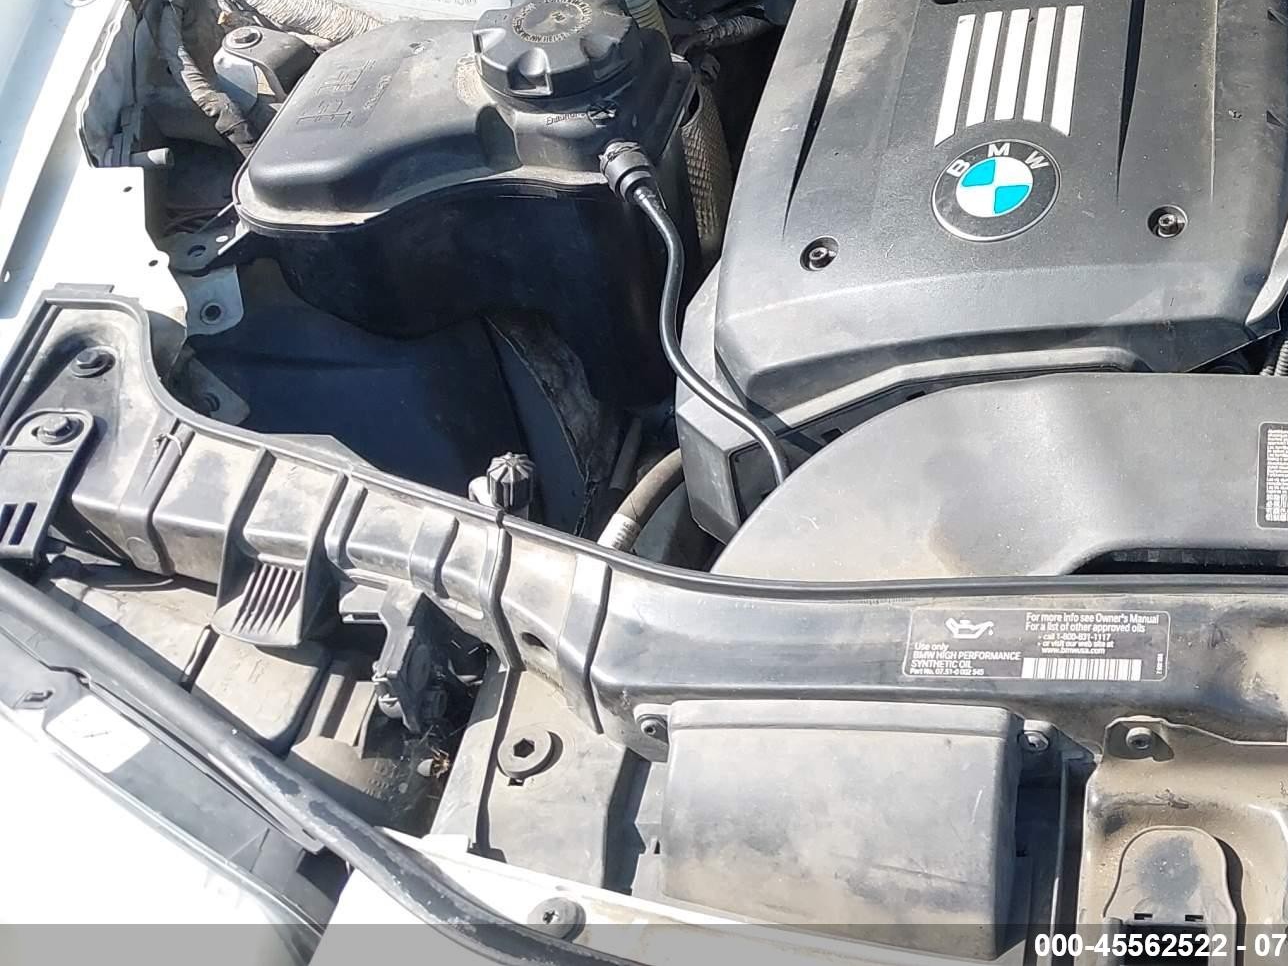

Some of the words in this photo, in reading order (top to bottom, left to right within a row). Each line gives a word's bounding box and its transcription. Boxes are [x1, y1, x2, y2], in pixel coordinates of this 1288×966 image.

[947, 143, 1050, 178] BMW
[1026, 612, 1039, 622] For
[1096, 613, 1127, 623] Owner's
[1130, 614, 1159, 624] Manual
[1026, 622, 1039, 631] For
[1047, 623, 1059, 631] list
[1062, 623, 1068, 631] of
[1070, 623, 1091, 631] other
[1093, 623, 1130, 632] approved
[932, 643, 949, 652] only
[913, 651, 935, 659] BMW
[936, 651, 956, 659] HIGH
[958, 651, 1021, 660] PERFORMANCE
[911, 660, 958, 668] SYNTHETIC
[959, 660, 972, 668] OIL
